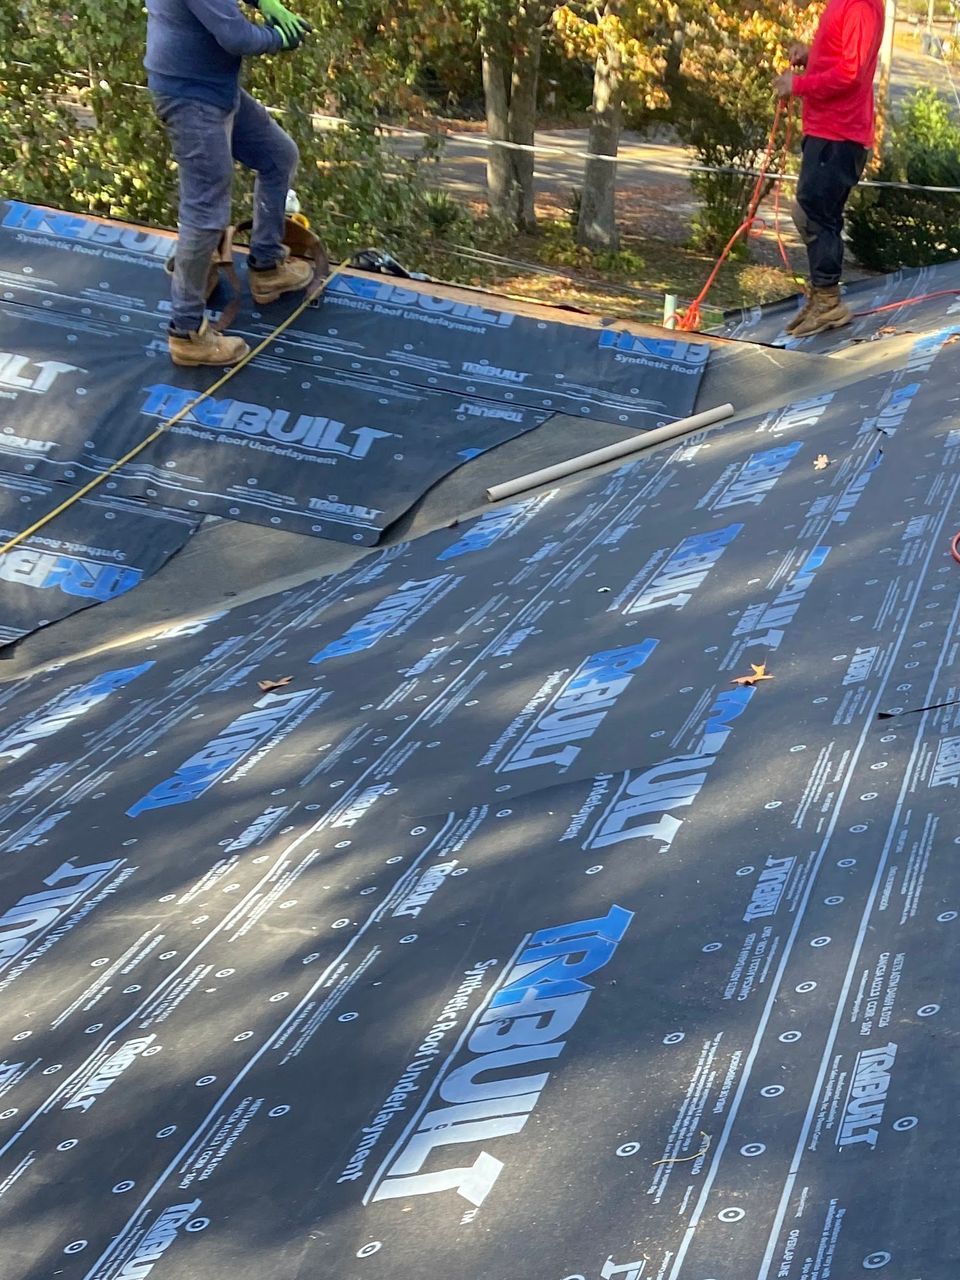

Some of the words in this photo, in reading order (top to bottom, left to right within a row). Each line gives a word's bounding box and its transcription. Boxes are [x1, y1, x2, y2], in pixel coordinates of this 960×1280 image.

[140, 384, 394, 459] TRIBUILT
[250, 439, 338, 466] Underlayment
[309, 498, 386, 520] TRIBUILT
[436, 957, 498, 1021] Synthetic
[372, 903, 636, 1208] TRIBUILT
[413, 1019, 457, 1059] Roof
[336, 1053, 439, 1184] Underlayment
[839, 1041, 898, 1148] TRIBUILT
[782, 1229, 800, 1261] OVERLAP
